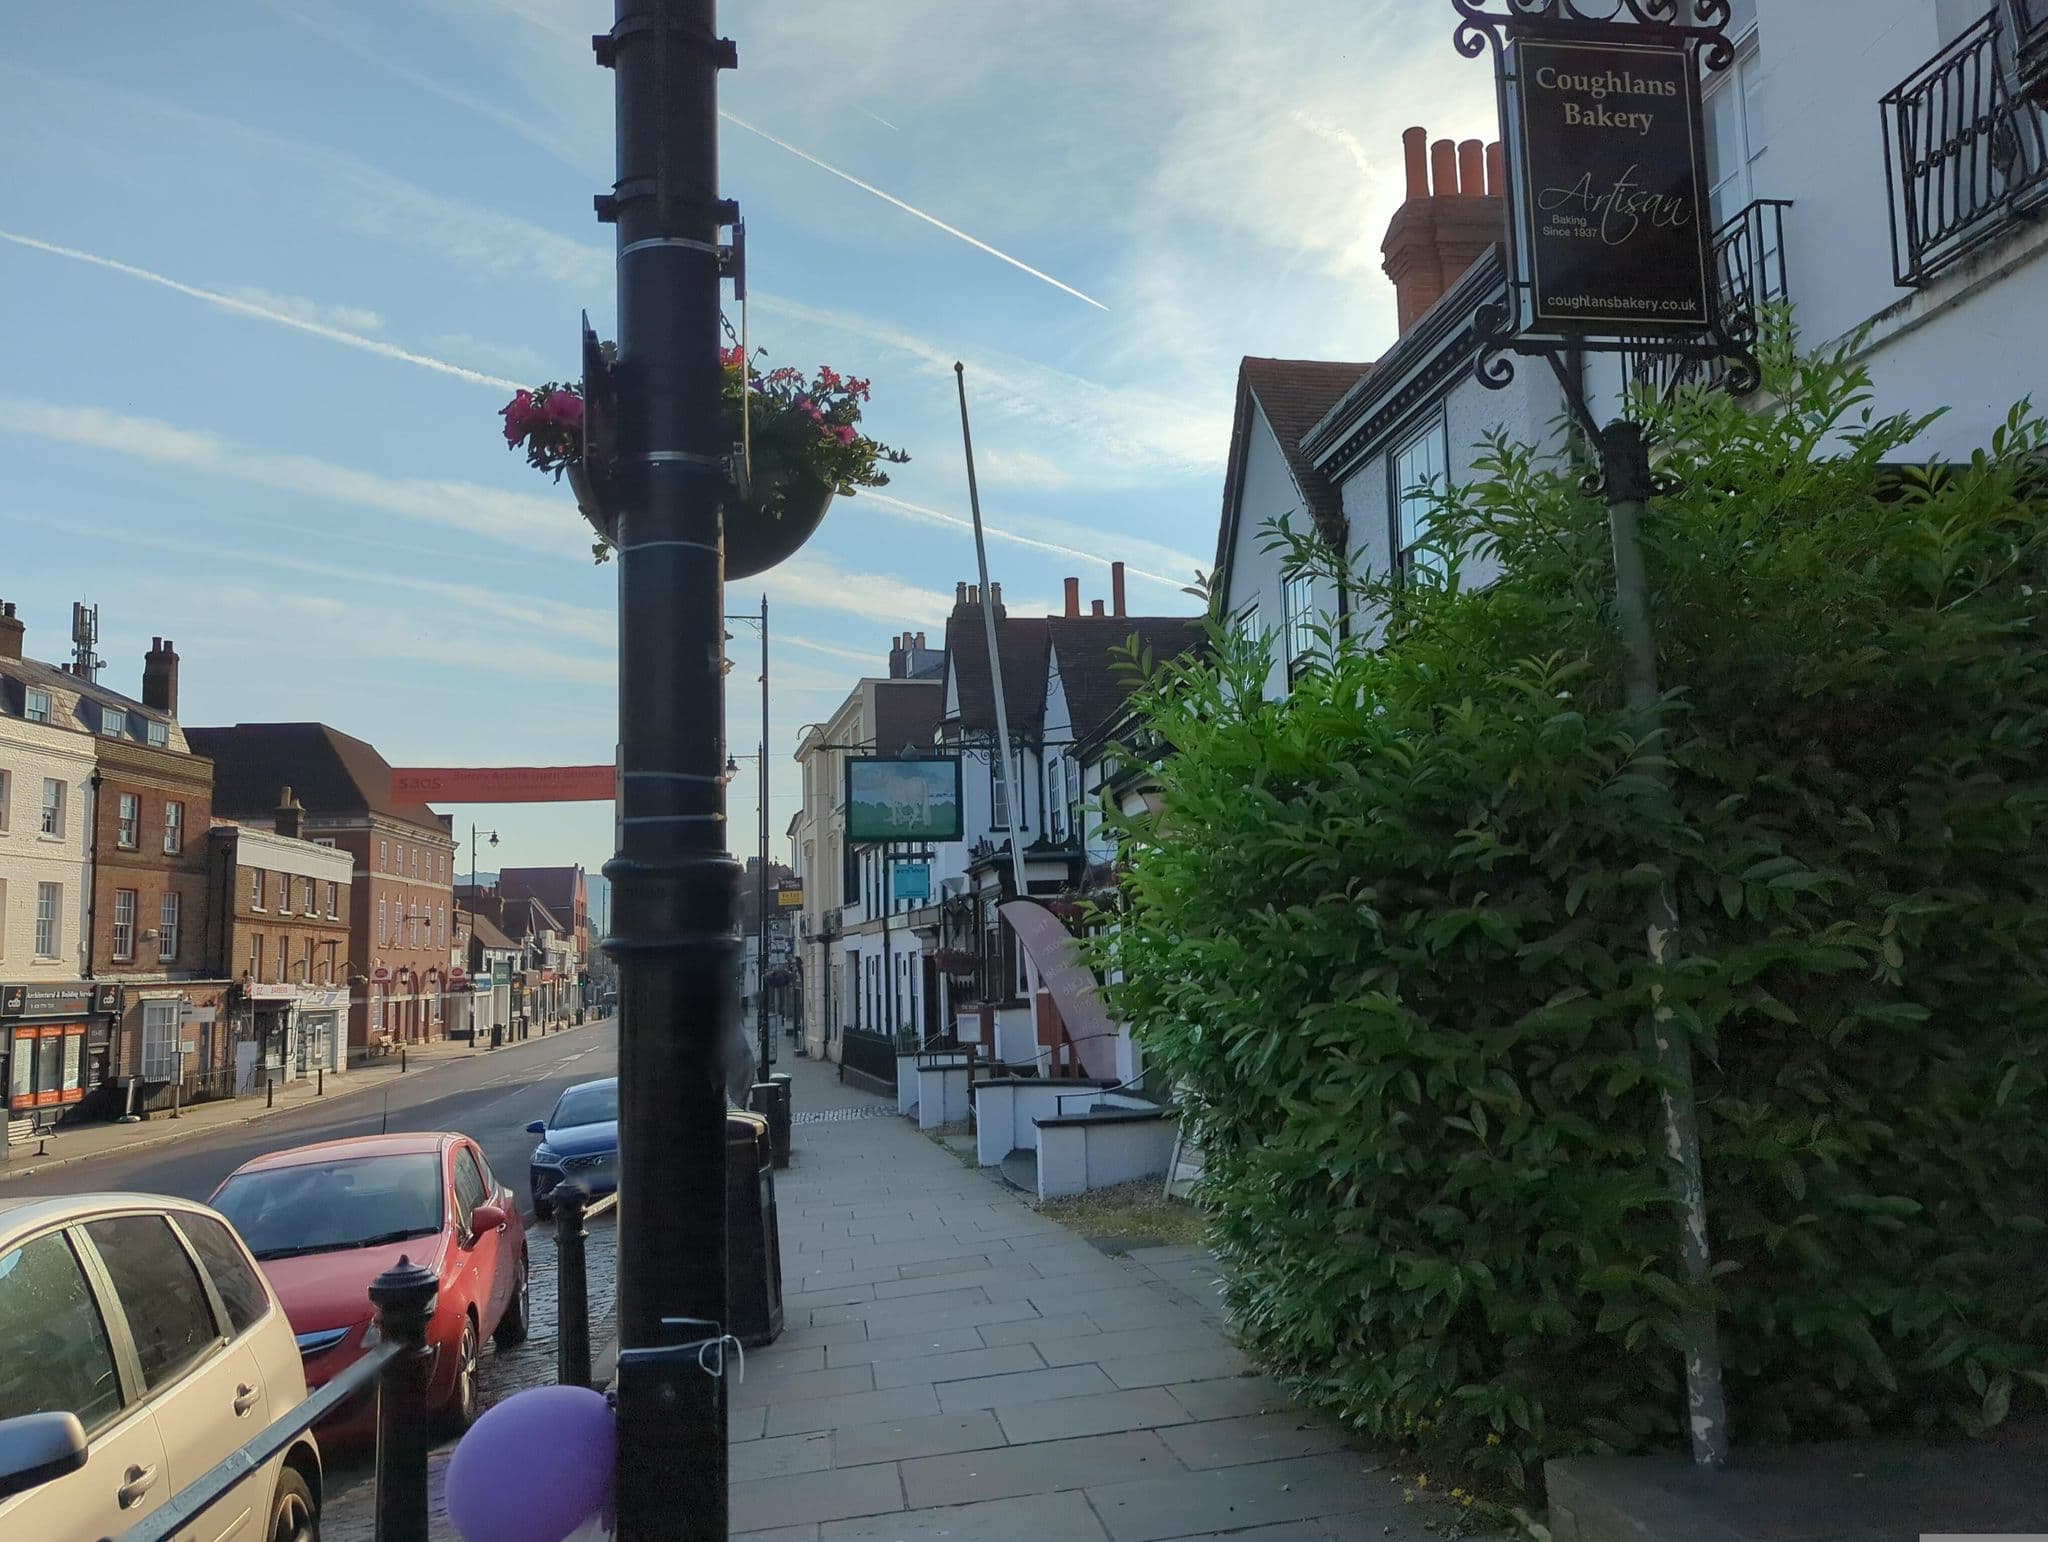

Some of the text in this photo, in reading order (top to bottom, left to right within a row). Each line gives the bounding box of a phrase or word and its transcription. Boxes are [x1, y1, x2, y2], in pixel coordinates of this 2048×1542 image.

[1535, 66, 1677, 99] Coughlans
[1562, 102, 1654, 136] Bakery
[1537, 163, 1692, 246] Artisan
[1542, 226, 1598, 238] Since 1937
[1552, 214, 1588, 226] Baking
[1547, 294, 1697, 311] coughlansbakery.co.uk
